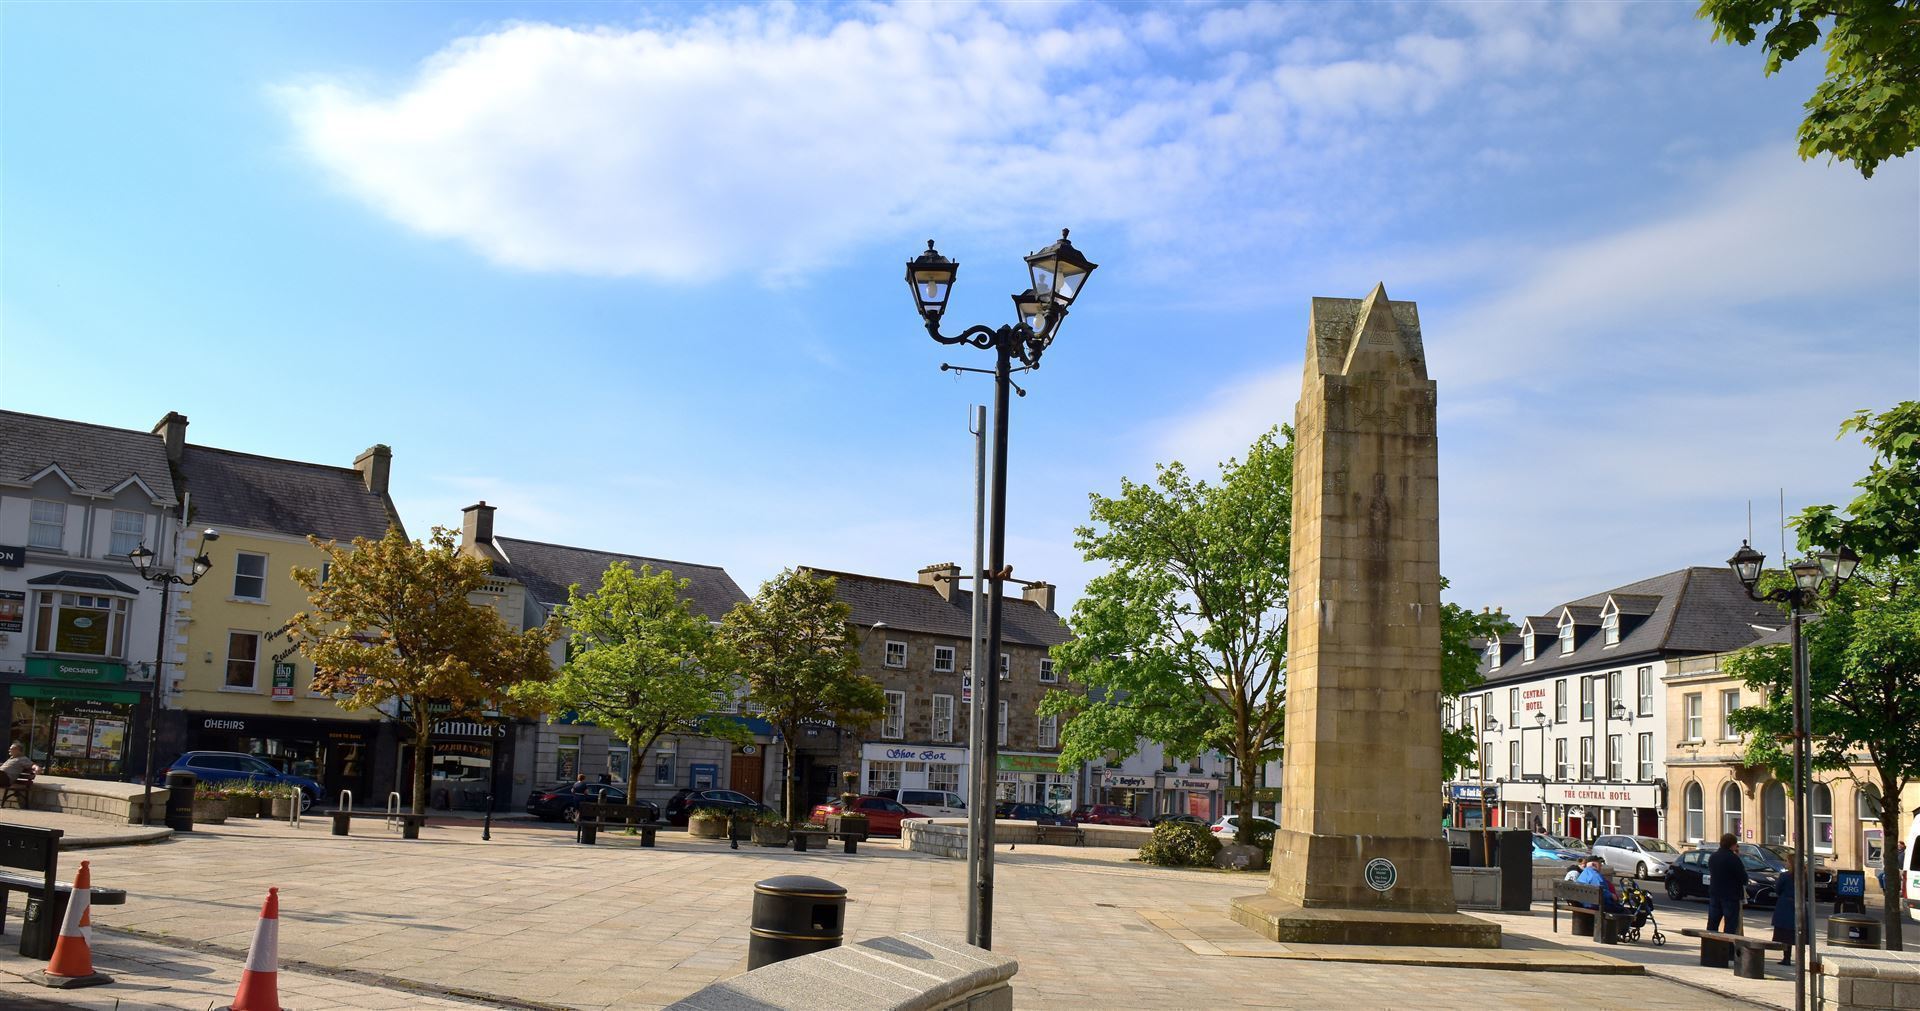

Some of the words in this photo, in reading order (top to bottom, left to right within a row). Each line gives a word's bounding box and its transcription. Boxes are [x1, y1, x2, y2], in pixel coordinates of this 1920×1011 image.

[59, 665, 98, 675] Specsavers
[1522, 688, 1546, 699] CENTRAL
[1526, 701, 1543, 711] HOTEL
[204, 718, 245, 730] O'HEHIRS
[886, 749, 915, 759] Shoe
[919, 751, 947, 761] Box
[1119, 776, 1146, 787] Begley's
[1182, 779, 1210, 789] Pharmacy
[1564, 790, 1575, 799] THE
[1578, 790, 1605, 800] CENTRAL
[1609, 791, 1631, 800] HOTEL
[1842, 877, 1860, 886] JW
